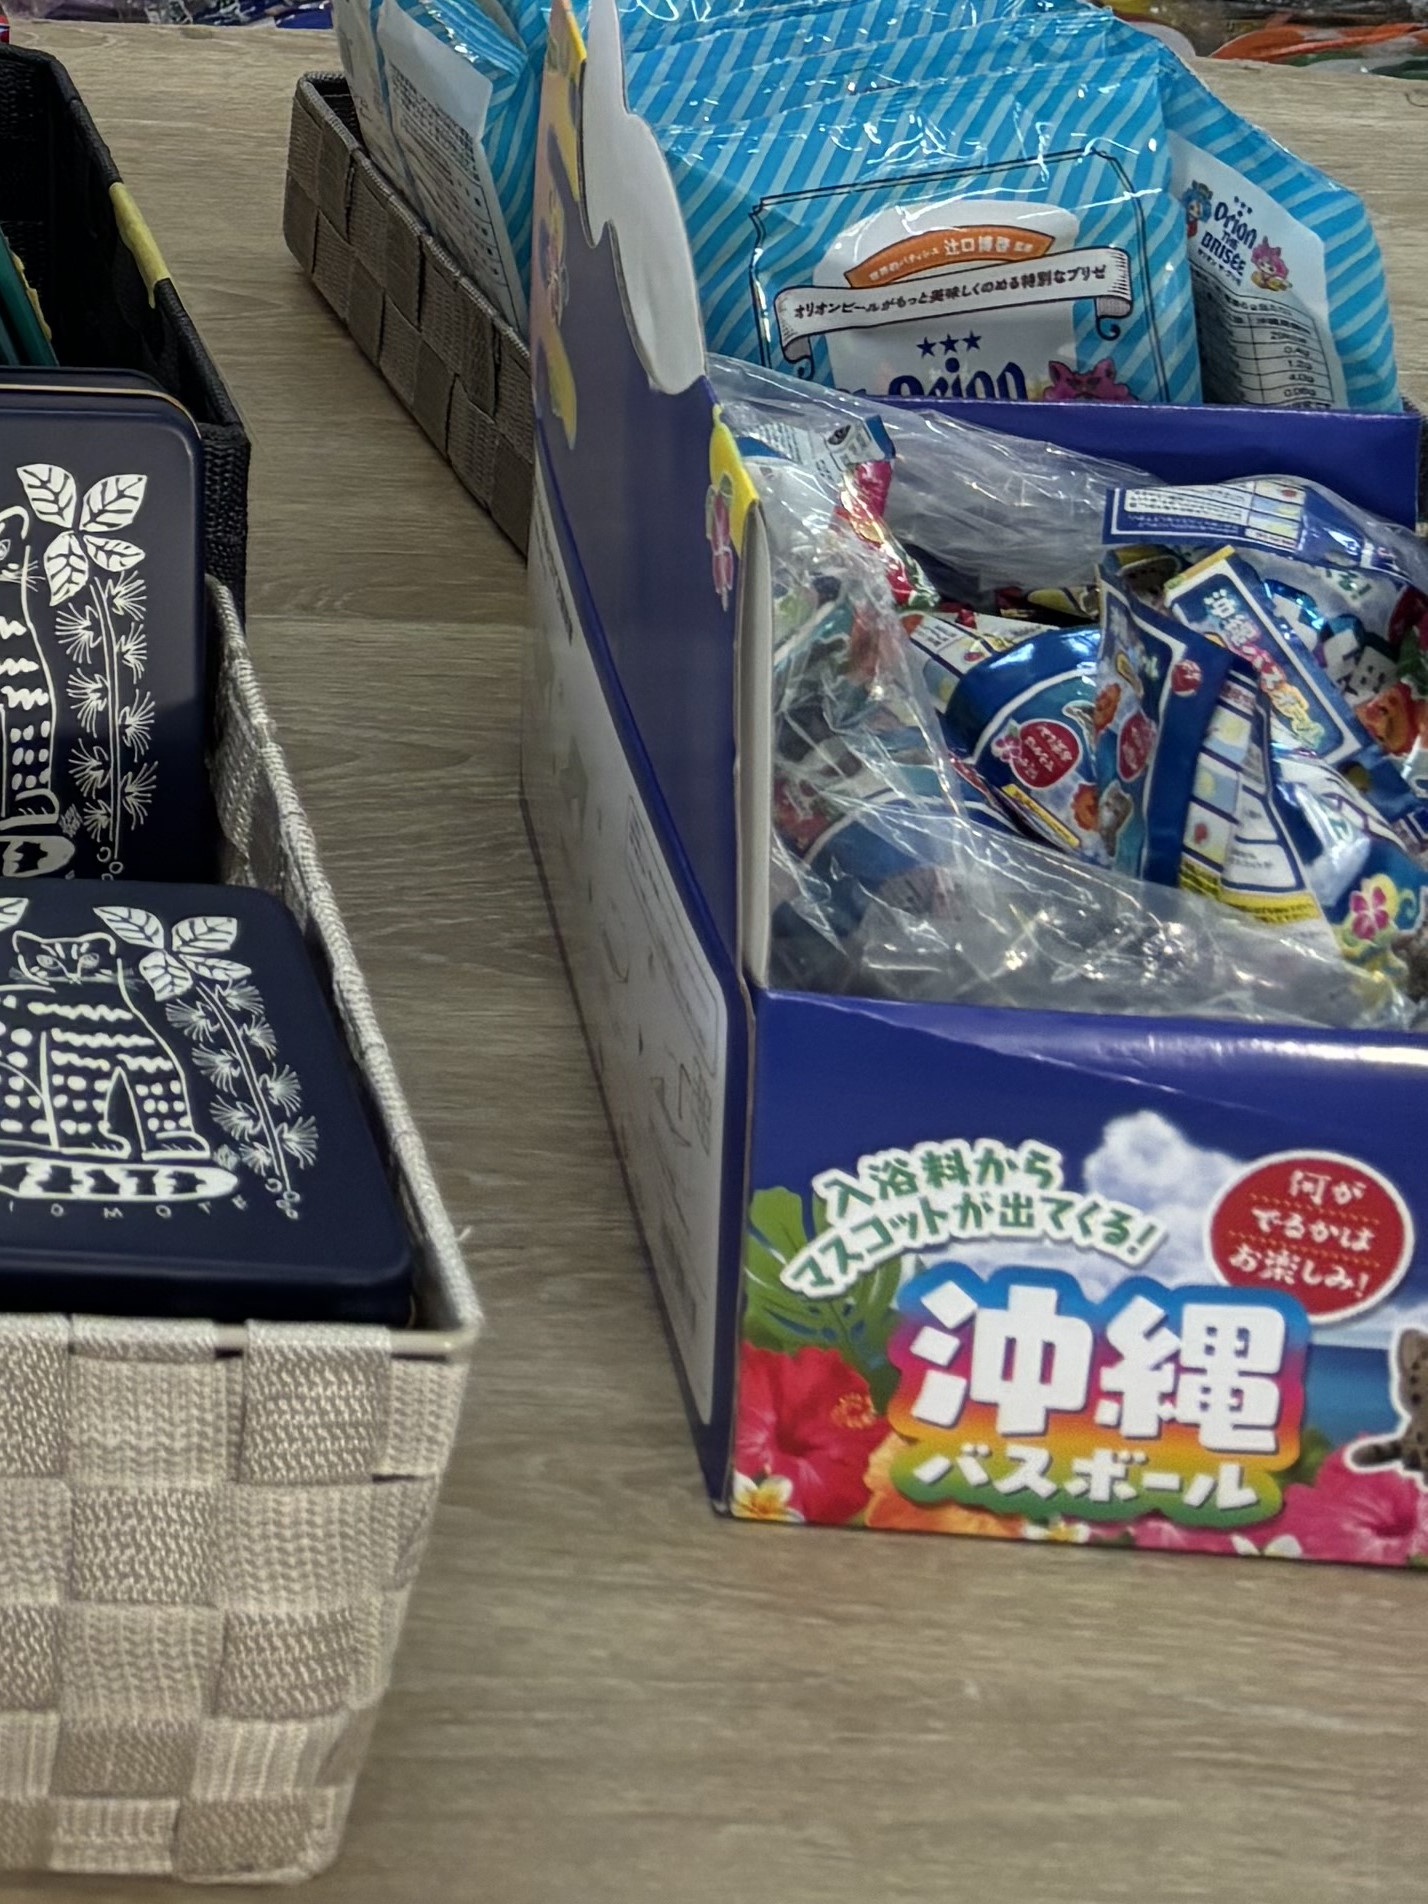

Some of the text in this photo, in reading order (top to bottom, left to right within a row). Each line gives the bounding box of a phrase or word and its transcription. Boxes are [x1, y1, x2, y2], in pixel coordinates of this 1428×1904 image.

[823, 1144, 1060, 1220] 入浴料から
[1290, 1168, 1366, 1202] 何が
[788, 1196, 1161, 1292] マスコットが出てくる!
[1251, 1207, 1375, 1252] でるかは
[1228, 1248, 1371, 1298] お楽しみ!
[911, 1280, 1287, 1455] 沖縄
[913, 1445, 1258, 1510] バスボール
